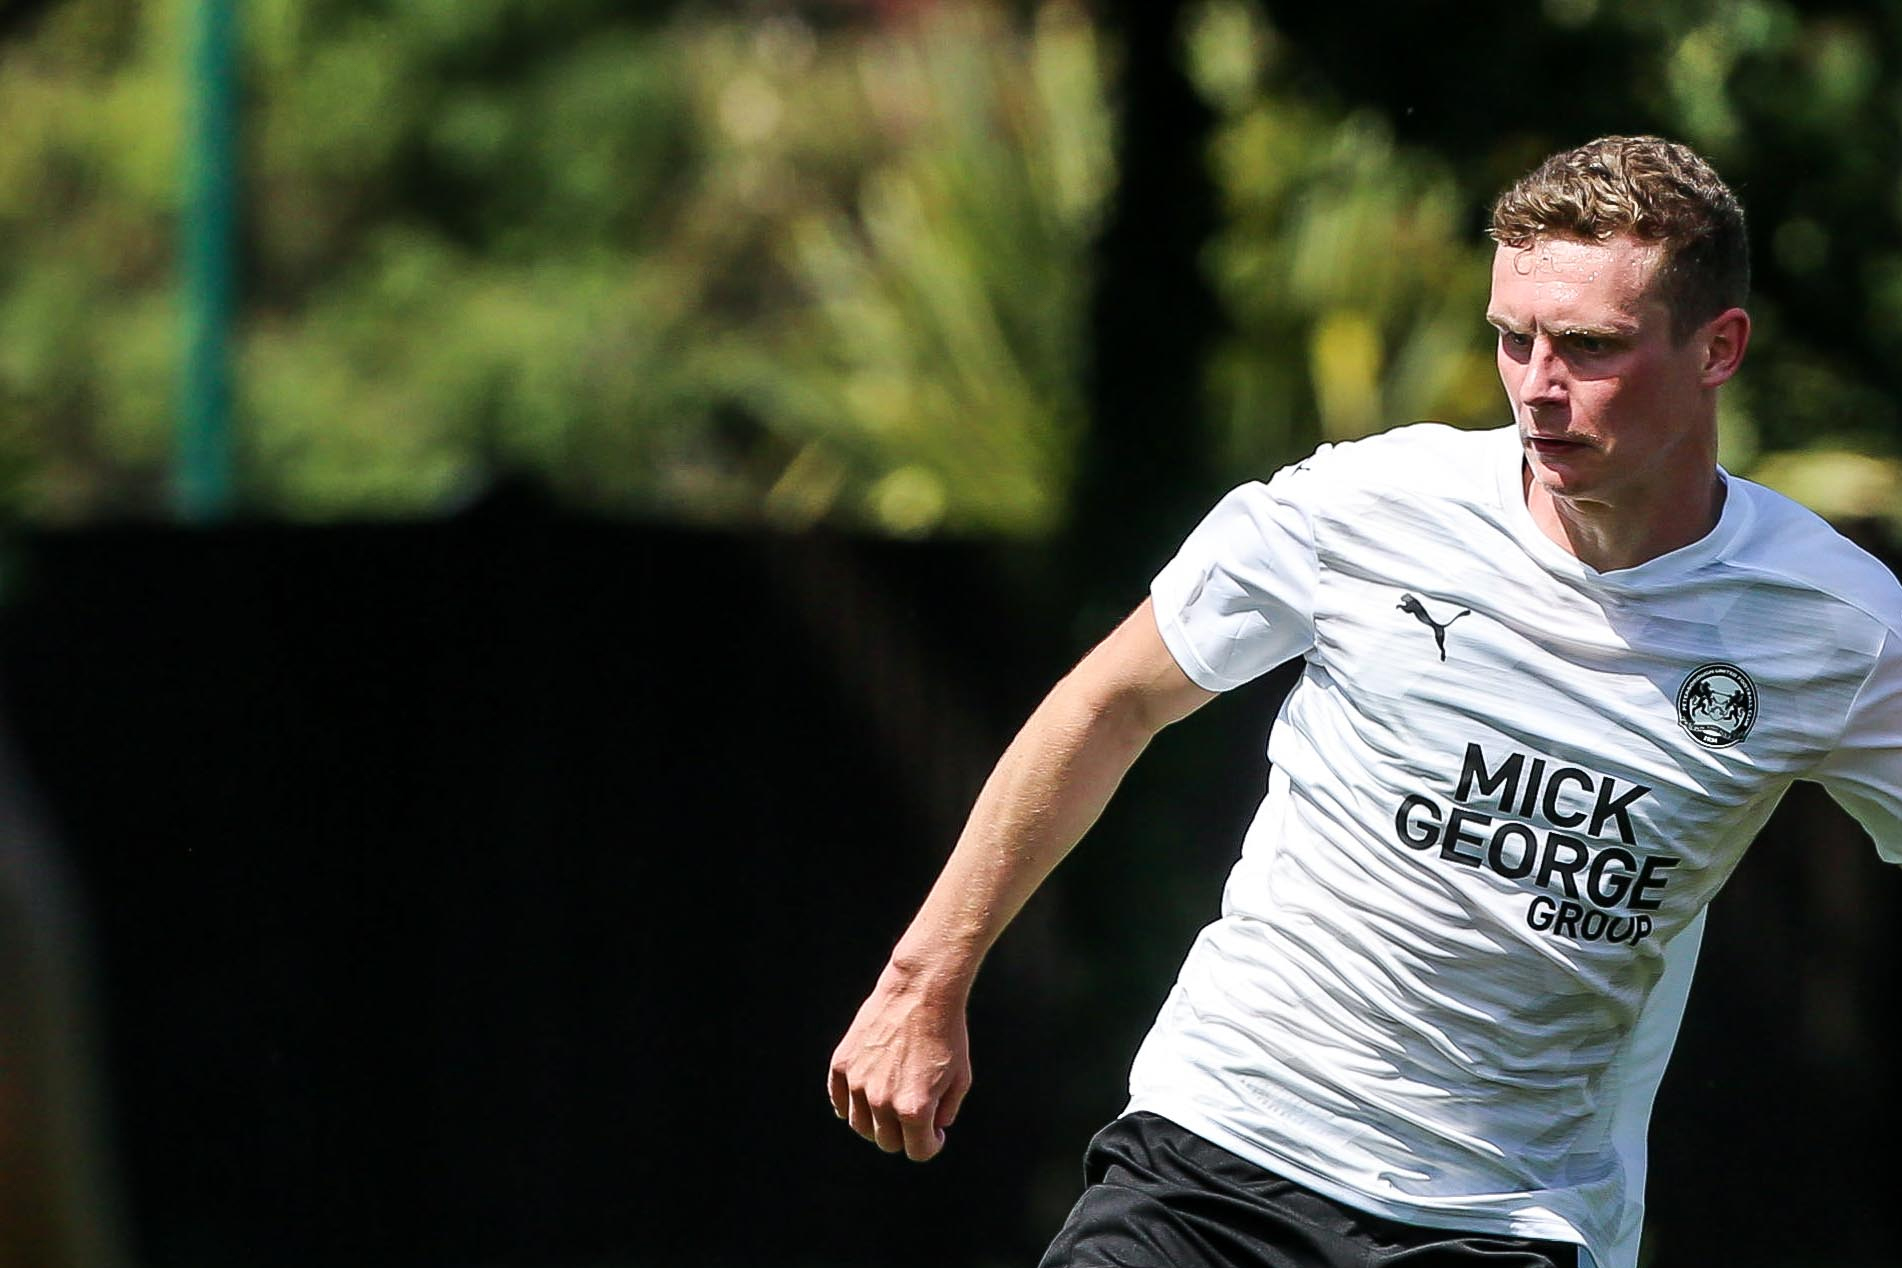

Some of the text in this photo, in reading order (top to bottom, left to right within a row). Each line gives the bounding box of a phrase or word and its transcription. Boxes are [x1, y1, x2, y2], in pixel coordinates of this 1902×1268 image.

[1454, 742, 1652, 846] MICK
[1395, 794, 1681, 910] GEORGE
[1526, 895, 1654, 947] GROUP
